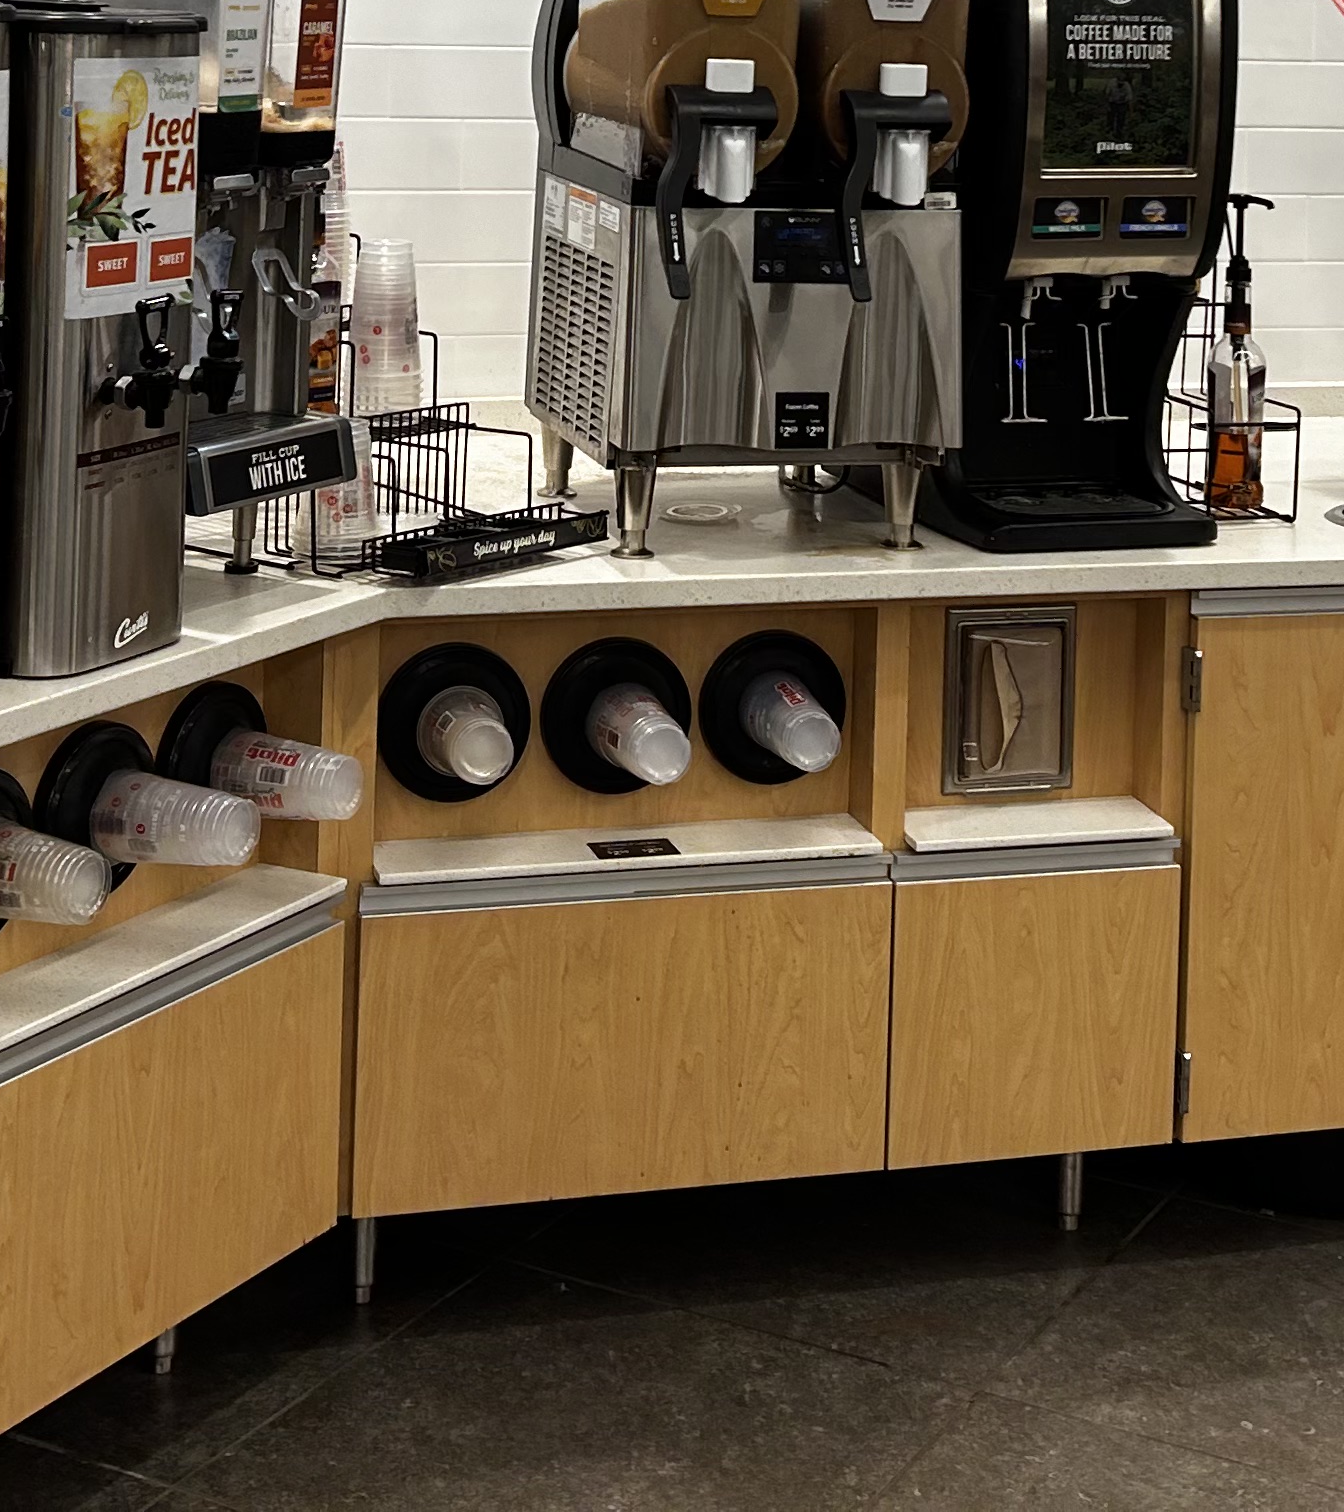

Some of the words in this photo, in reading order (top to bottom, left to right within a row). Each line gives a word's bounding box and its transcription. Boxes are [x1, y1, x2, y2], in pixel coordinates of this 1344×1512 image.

[1066, 24, 1110, 41] COFFEE
[1113, 25, 1147, 41] MADE
[1150, 25, 1173, 41] FOR
[1066, 44, 1076, 59] A
[1078, 43, 1123, 60] BETTER
[1126, 44, 1171, 60] FUTURE
[145, 107, 196, 147] Iced
[1096, 141, 1133, 154] pilot
[141, 149, 196, 195] TEA
[670, 213, 678, 240] PUSH
[850, 218, 859, 244] PUSH
[97, 257, 128, 272] SWEET
[158, 252, 186, 267] SWEET
[252, 450, 276, 464] FILL
[279, 445, 299, 457] CUP
[249, 460, 283, 490] WITH
[285, 455, 307, 482] ICE
[474, 541, 498, 560] Spice
[500, 540, 512, 554] up
[514, 534, 536, 553] your
[538, 530, 556, 546] day
[114, 612, 149, 648] Curtis
[246, 747, 301, 767] pilot
